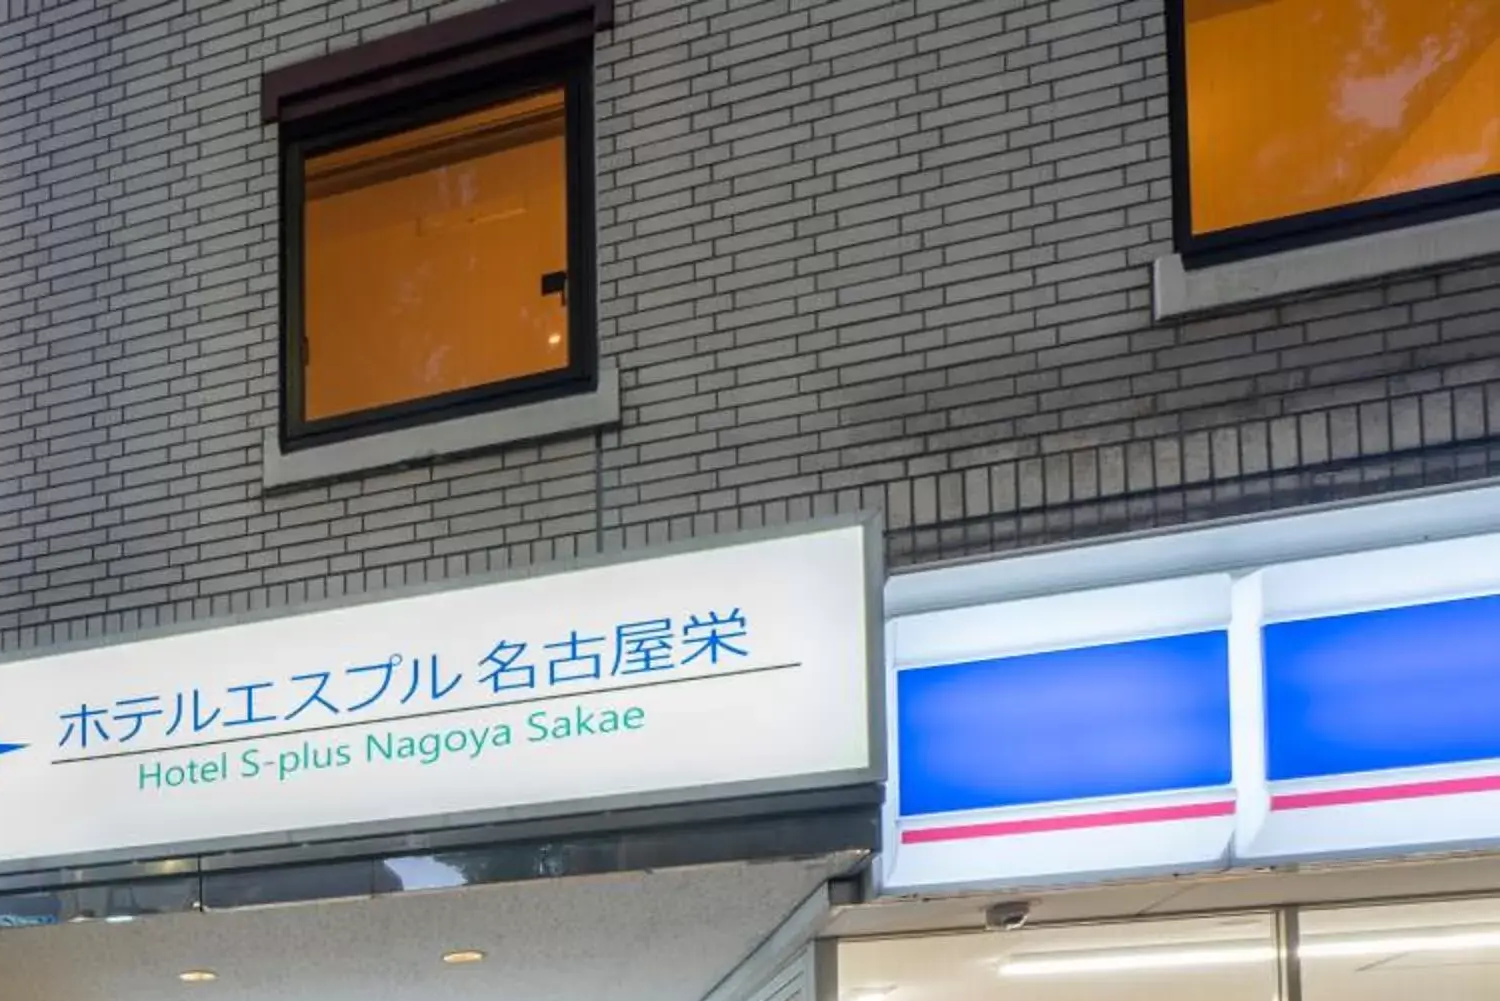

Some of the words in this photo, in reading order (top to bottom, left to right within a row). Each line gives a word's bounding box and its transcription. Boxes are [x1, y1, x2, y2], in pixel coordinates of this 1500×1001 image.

[59, 654, 463, 750] ホテルエスプル
[477, 607, 749, 694] 名古屋栄
[139, 751, 227, 790] Hotel
[241, 738, 351, 780] S-plus
[365, 724, 512, 765] Nagoya
[527, 706, 646, 744] Sakae
